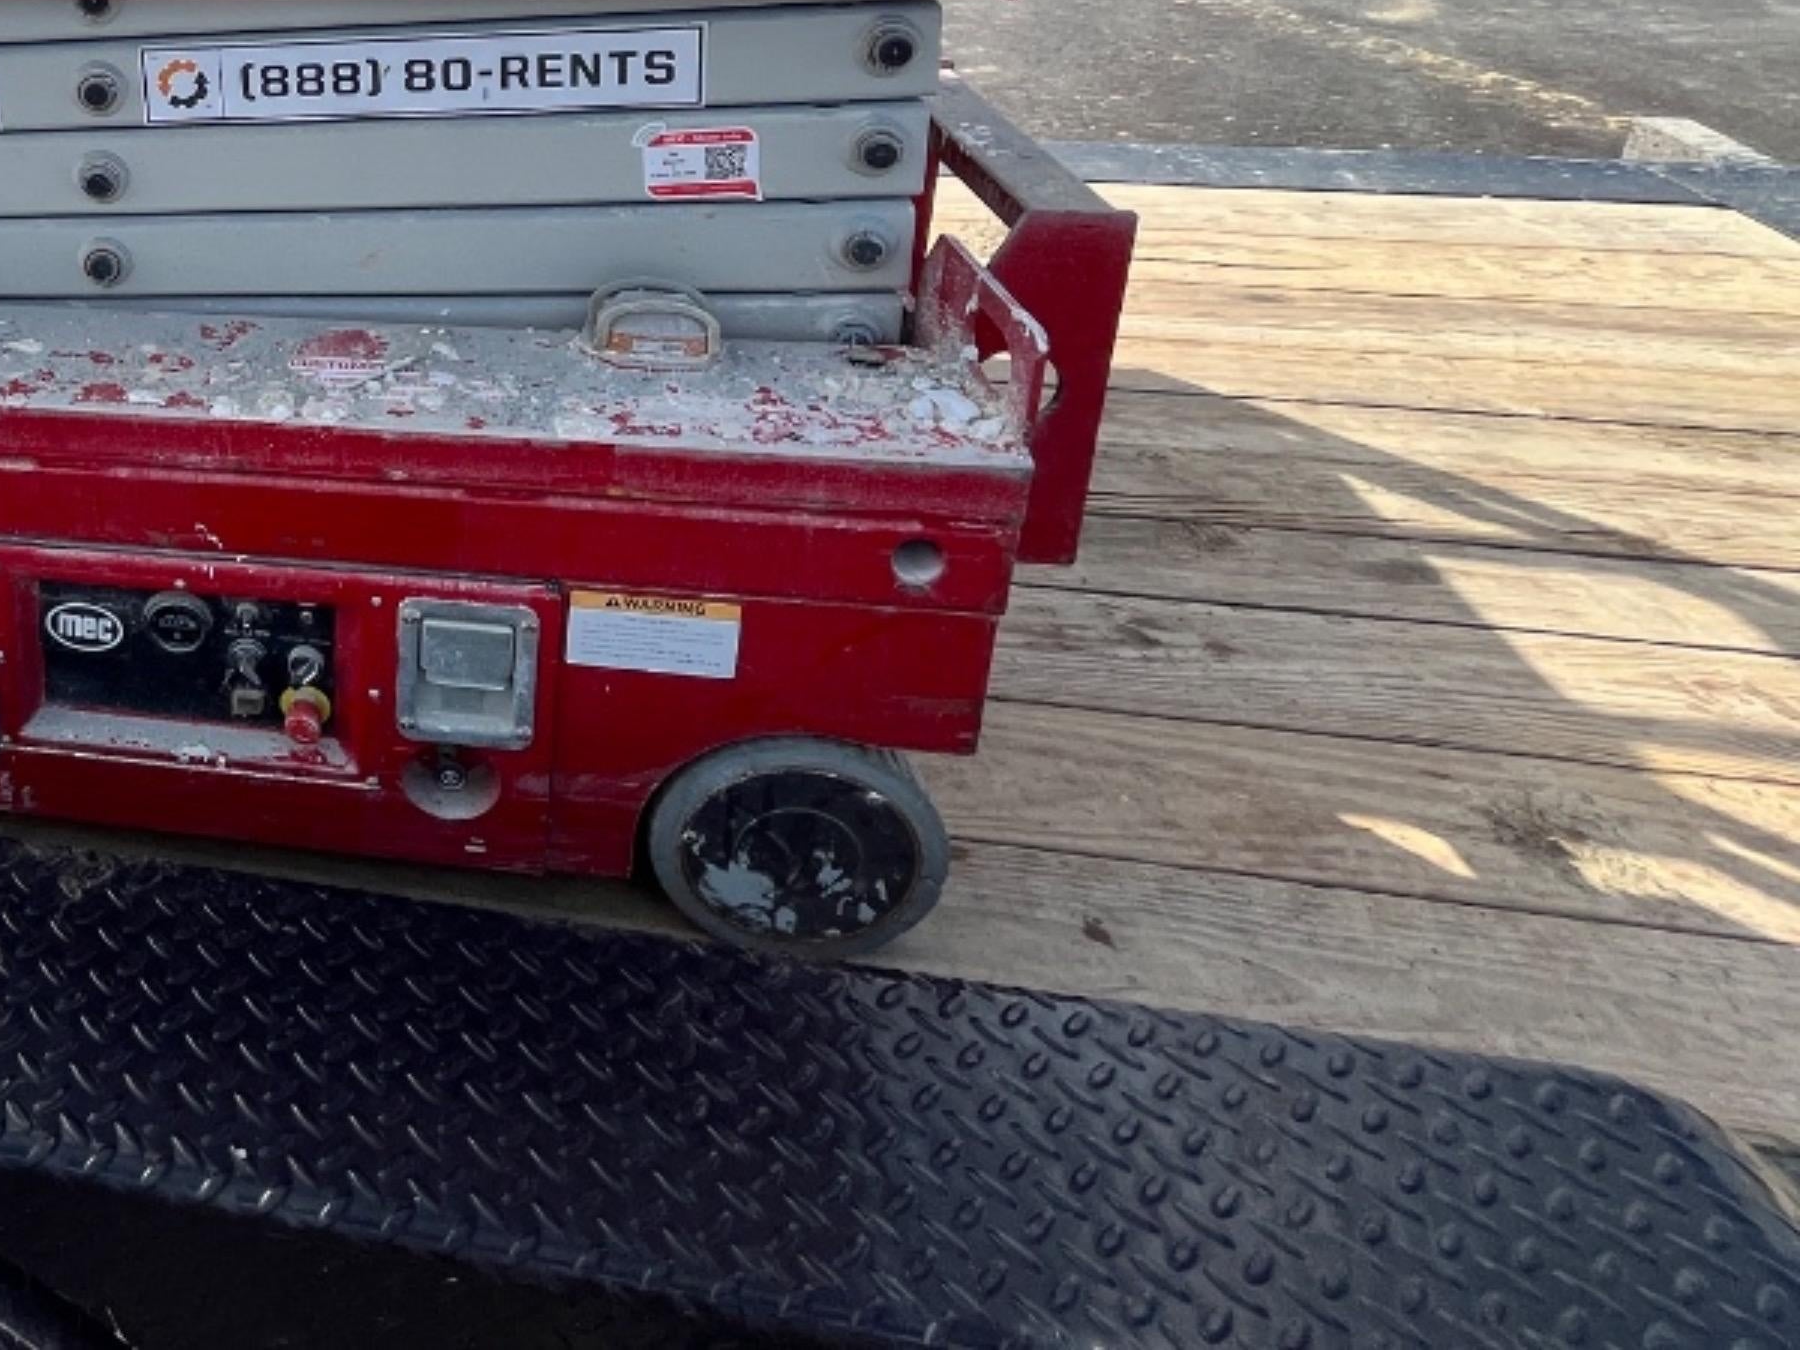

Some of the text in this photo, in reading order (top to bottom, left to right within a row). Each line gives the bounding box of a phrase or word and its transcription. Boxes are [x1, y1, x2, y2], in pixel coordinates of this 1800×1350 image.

[240, 49, 677, 102] (888) 80-RENTS
[624, 596, 706, 617] WARNING
[57, 613, 113, 642] mec
